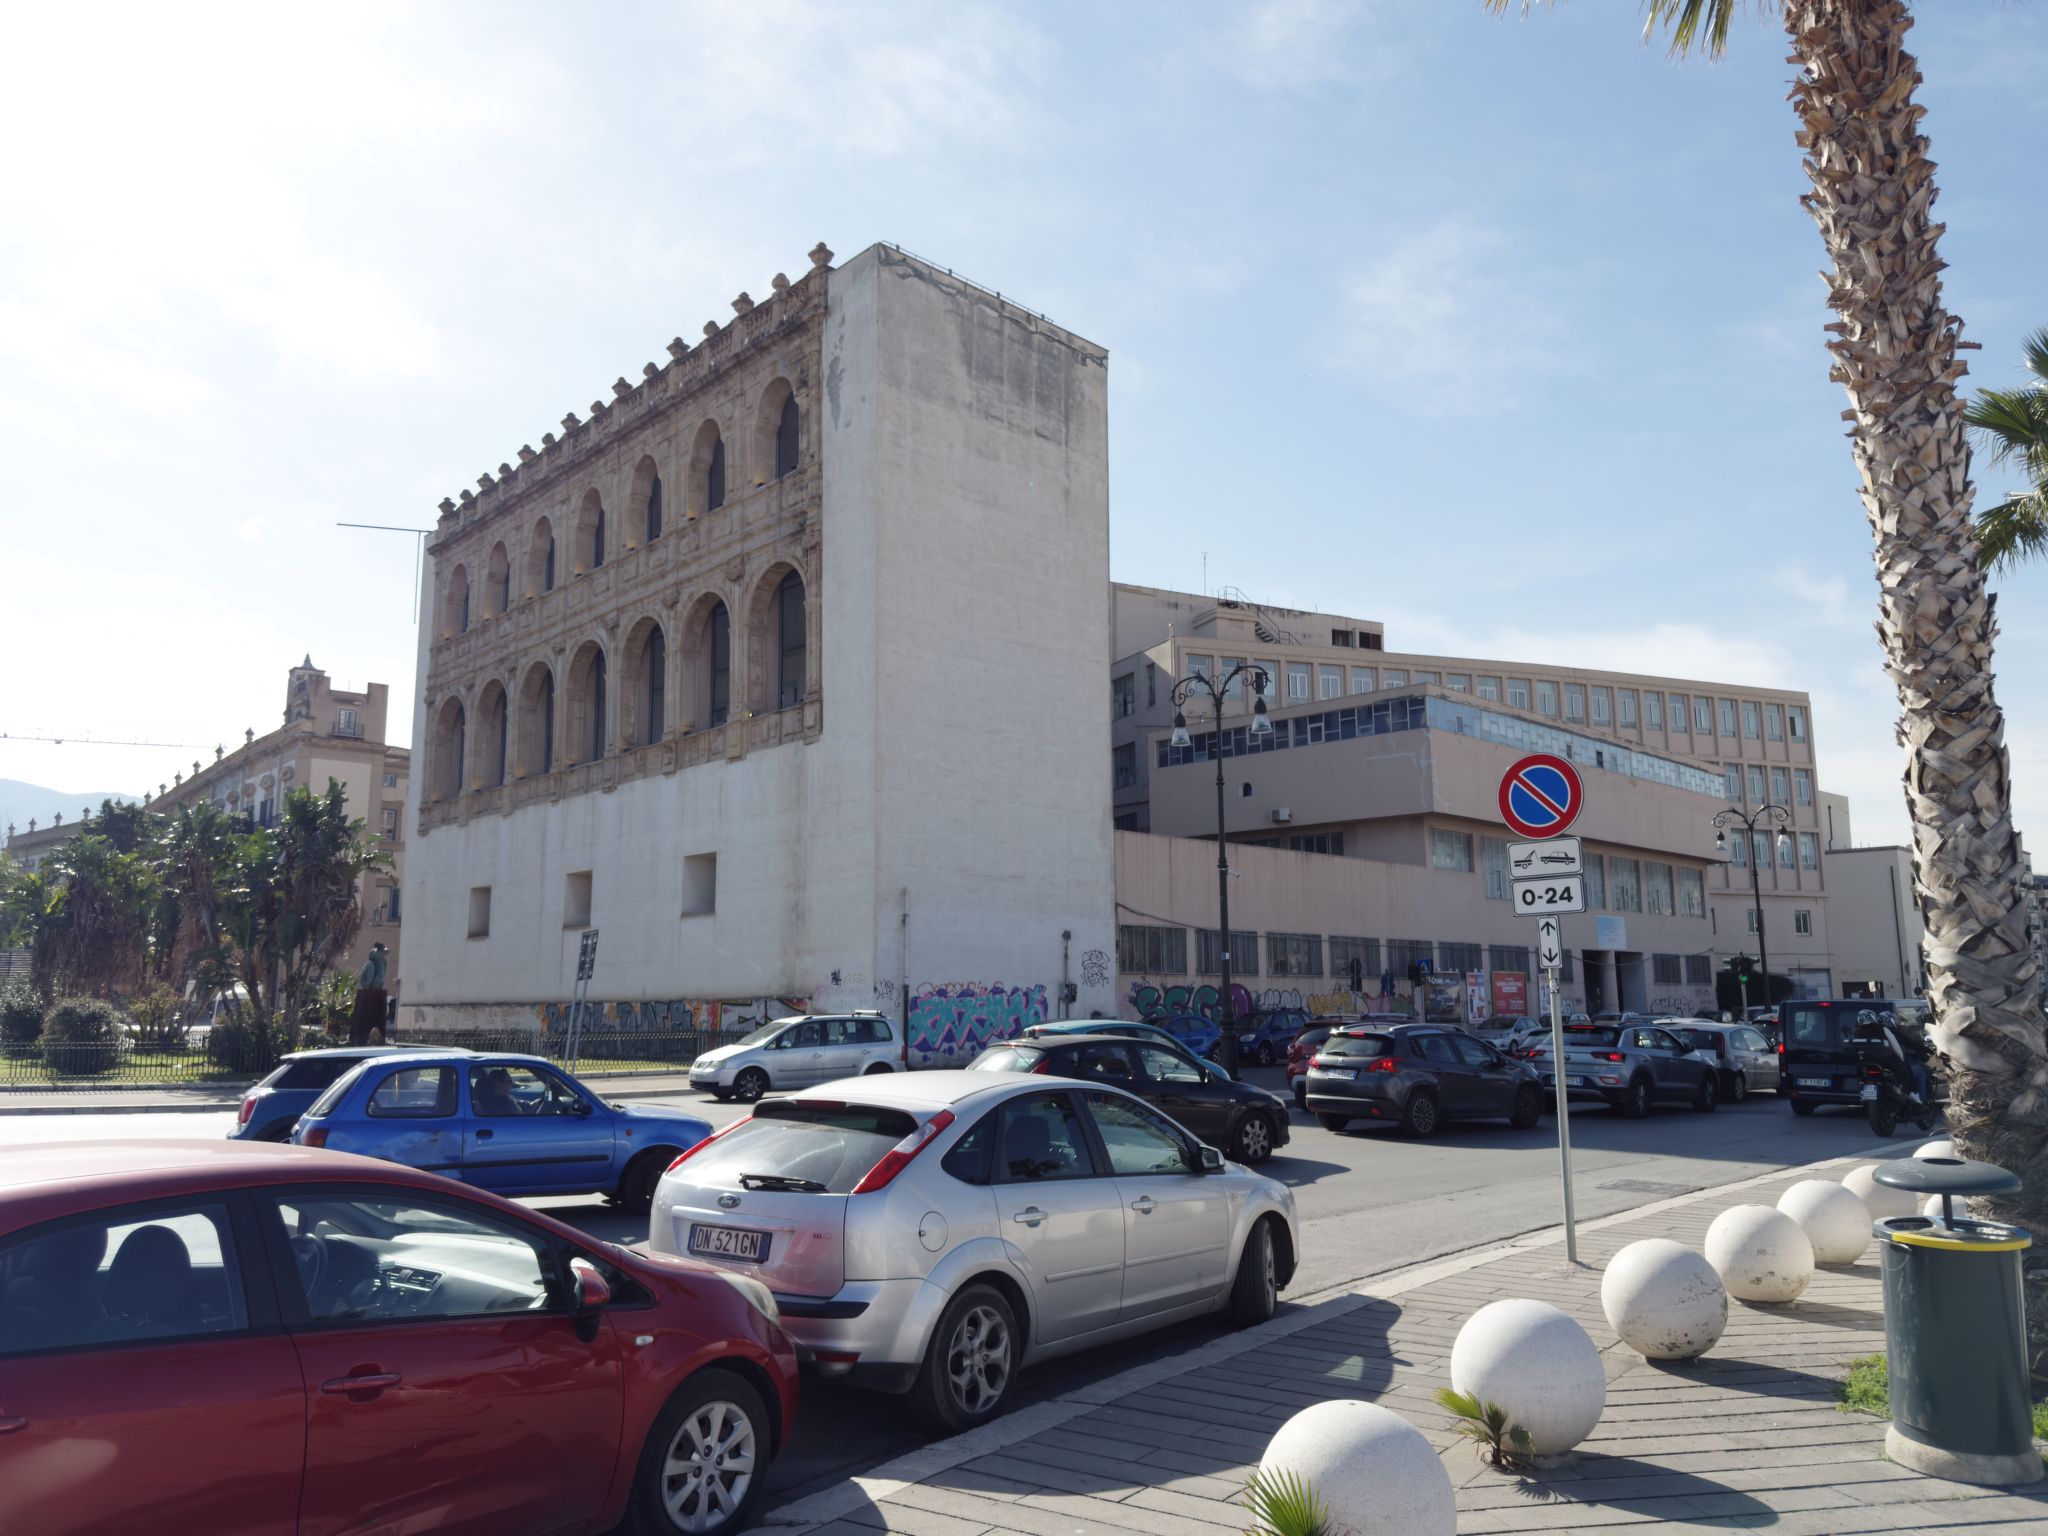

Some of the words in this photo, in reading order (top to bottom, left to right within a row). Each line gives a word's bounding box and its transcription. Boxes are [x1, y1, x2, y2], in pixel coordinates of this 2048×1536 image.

[1522, 886, 1573, 906] 0-24
[695, 1228, 712, 1249] DN
[715, 1231, 759, 1256] 521GN
